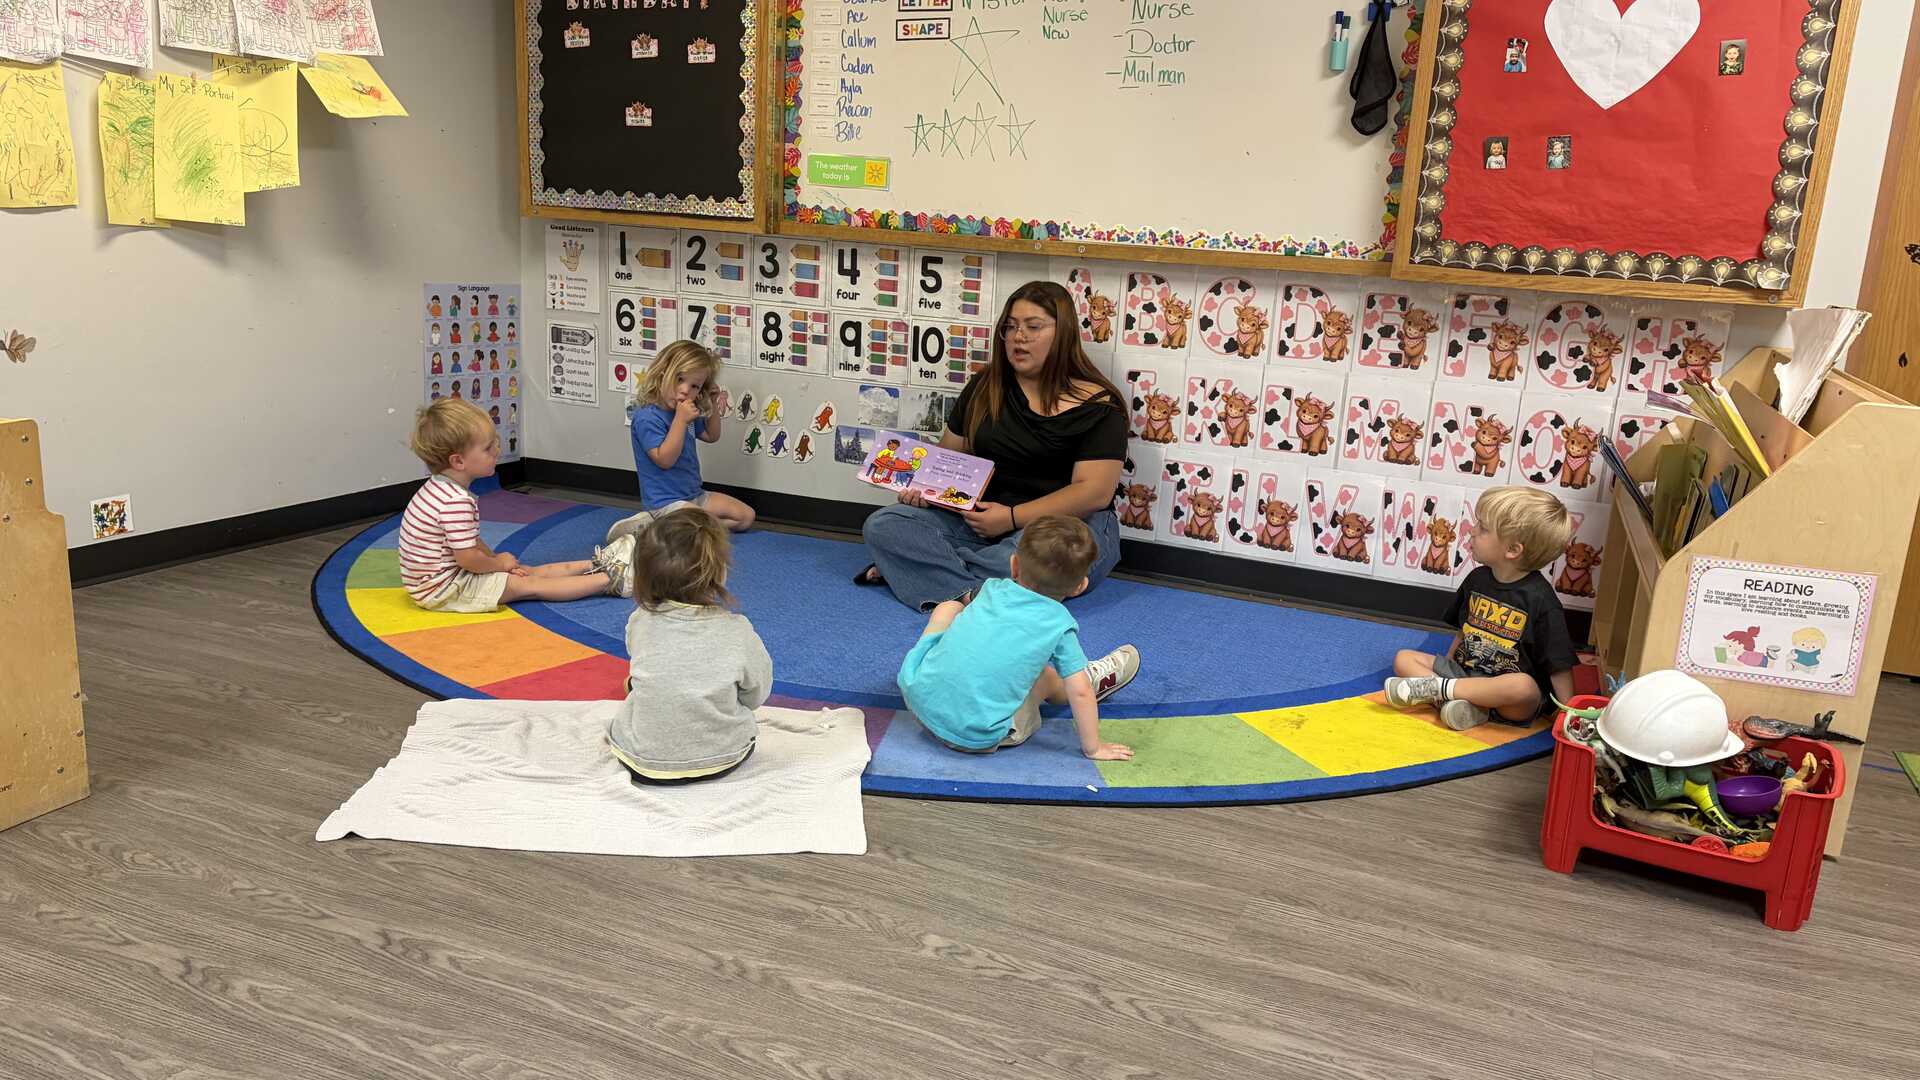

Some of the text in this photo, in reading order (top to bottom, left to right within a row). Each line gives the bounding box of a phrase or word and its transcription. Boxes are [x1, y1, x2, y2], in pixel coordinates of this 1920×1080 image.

[847, 11, 869, 24] Ace
[1043, 6, 1088, 22] Nurse
[1132, 0, 1195, 20] Nurse
[841, 29, 877, 49] Callum
[902, 23, 943, 36] SHAPE
[1125, 29, 1195, 54] Doctor
[159, 75, 175, 97] My
[815, 160, 857, 172] The weather
[822, 171, 850, 181] today is
[567, 225, 595, 233] Listeners
[620, 231, 626, 266] 1
[687, 235, 706, 271] 2
[759, 242, 780, 278] 3
[615, 271, 632, 281] one
[686, 274, 706, 286] two
[837, 248, 860, 285] 4
[920, 256, 944, 293] 5
[755, 282, 784, 295] three
[836, 289, 860, 301] four
[918, 298, 942, 310] five
[616, 298, 635, 332] 6
[687, 305, 707, 340] 7
[1122, 272, 1170, 347] B
[1198, 276, 1257, 356] C
[1278, 284, 1332, 360] D
[619, 337, 632, 347] six
[762, 311, 783, 347] 8
[839, 320, 863, 357] 9
[912, 325, 945, 364] 10
[1358, 292, 1409, 368] E
[1443, 293, 1508, 377] F
[1533, 301, 1605, 390] G
[759, 350, 785, 364] eight
[839, 360, 861, 372] nine
[919, 367, 937, 379] ten
[1624, 316, 1699, 395] H
[1184, 376, 1234, 447] K
[1260, 385, 1303, 453] L
[1343, 396, 1400, 462] M
[1427, 402, 1486, 473] N
[1517, 410, 1569, 485] O
[1162, 459, 1214, 537] T
[1226, 469, 1279, 546] U
[1305, 480, 1360, 556] V
[1382, 490, 1438, 569] W
[1744, 579, 1814, 597] READING
[1796, 604, 1834, 612] communicate
[1817, 611, 1842, 619] learning
